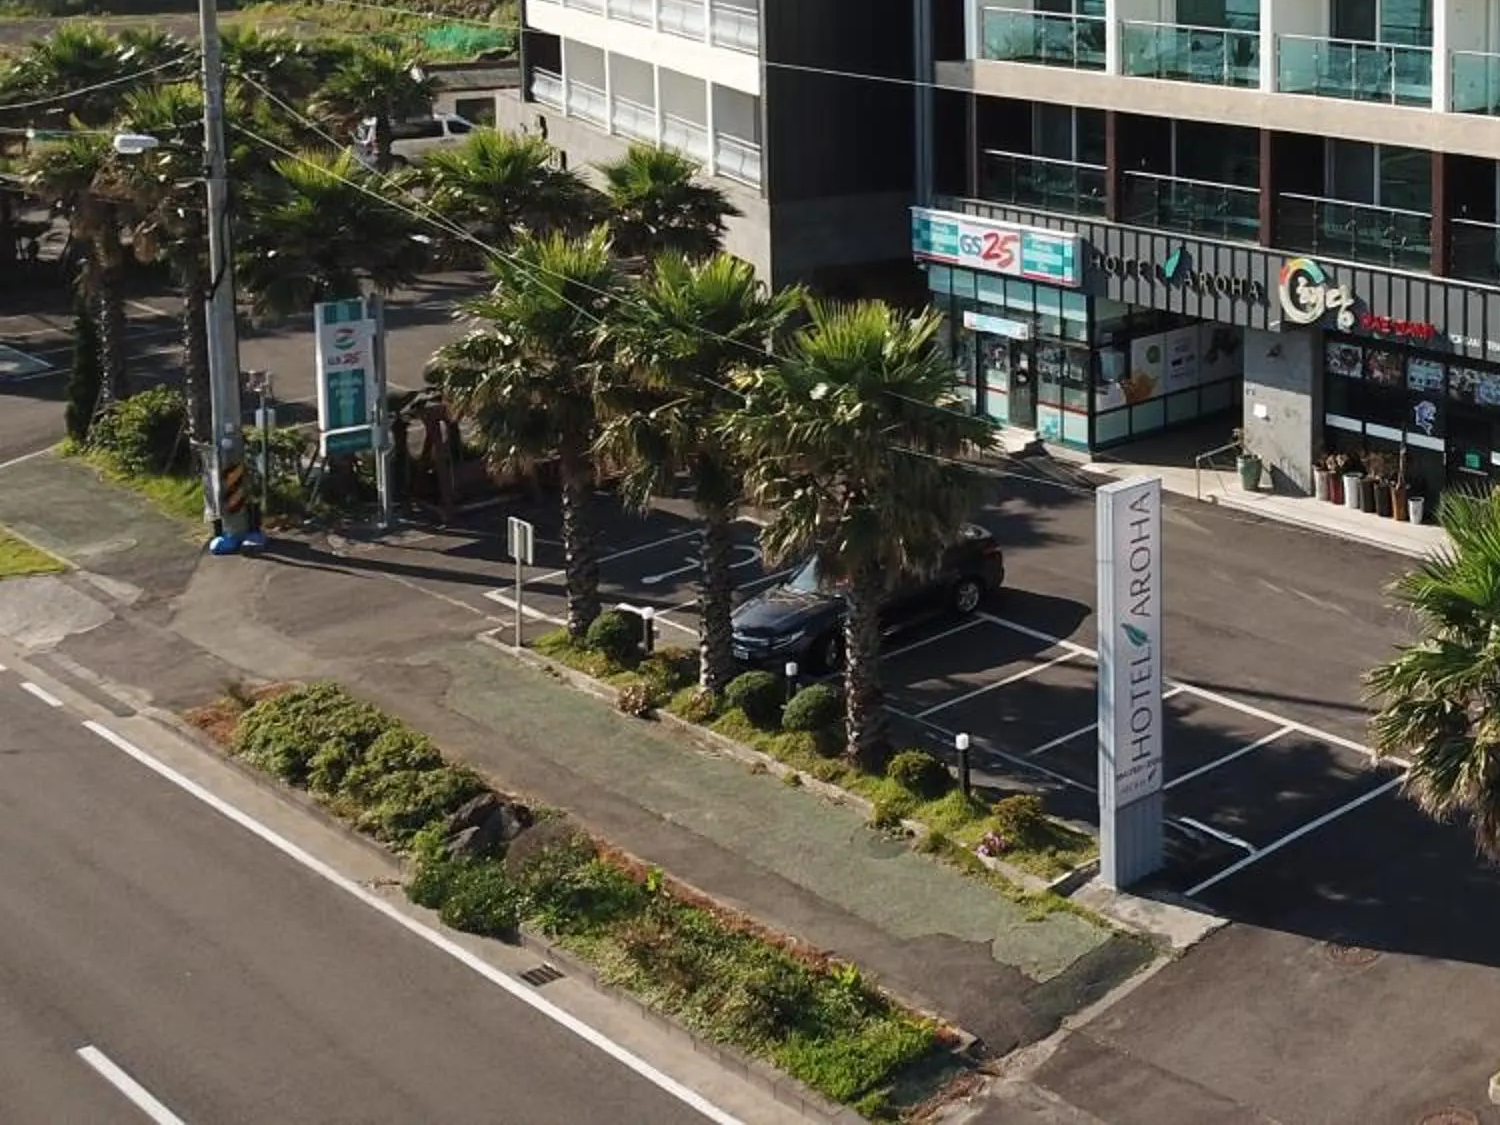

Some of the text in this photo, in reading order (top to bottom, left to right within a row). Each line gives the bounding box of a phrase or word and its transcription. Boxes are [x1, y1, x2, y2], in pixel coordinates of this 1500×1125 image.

[959, 231, 1020, 269] GS25
[1089, 254, 1261, 299] HOTEL AROHA
[1449, 333, 1481, 348] KORAN
[1129, 490, 1152, 619] AROHA
[1130, 647, 1153, 764] HOTEL
